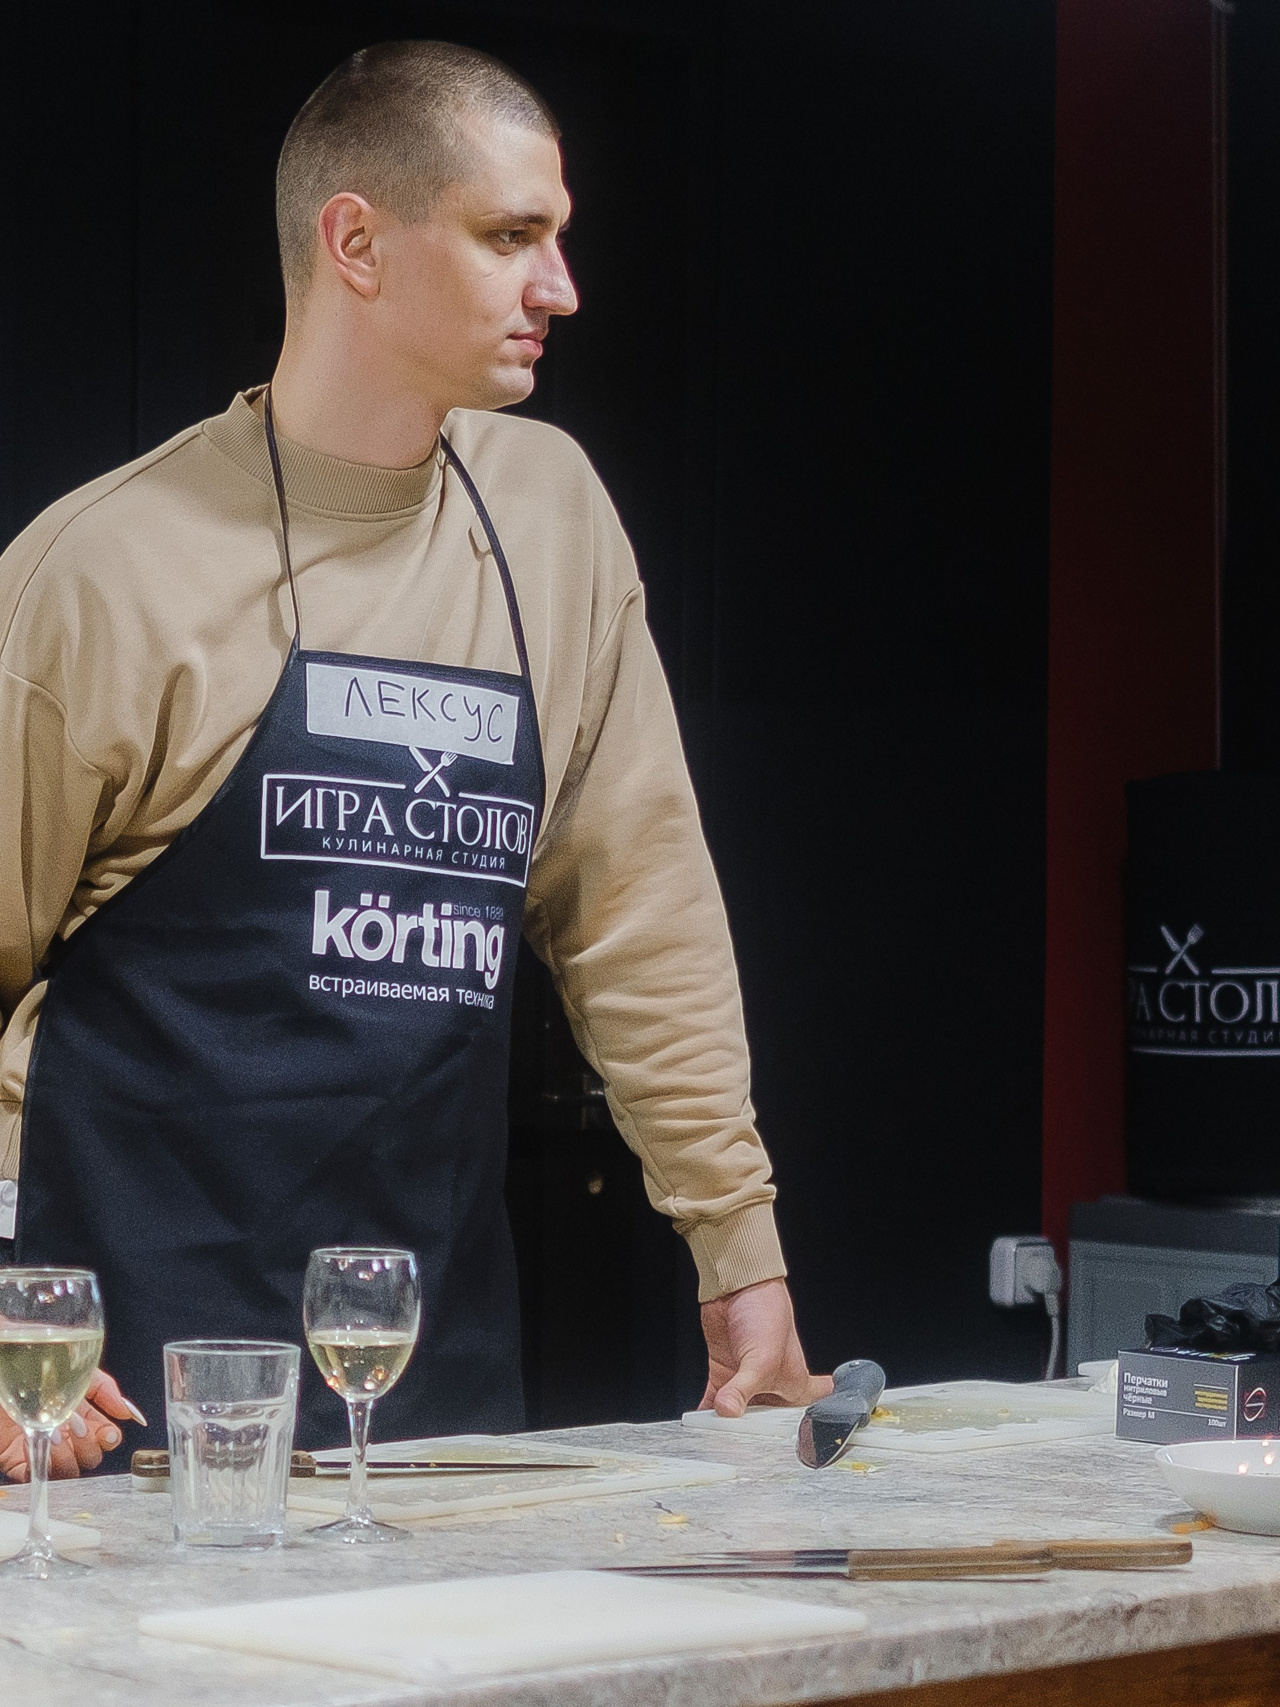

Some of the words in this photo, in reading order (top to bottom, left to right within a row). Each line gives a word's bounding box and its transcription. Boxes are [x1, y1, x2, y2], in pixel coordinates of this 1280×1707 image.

[344, 676, 504, 744] ЛЕКСУС
[275, 785, 395, 836] ИГРА
[405, 798, 530, 855] СТОЛОВ
[322, 836, 443, 863] КУЛИНАРНАЯ
[451, 850, 506, 871] СТУДИЯ
[453, 904, 481, 918] since
[312, 889, 505, 990] körting
[309, 974, 450, 1002] встраиваемая
[1208, 1029, 1280, 1045] СТУДИ
[1123, 1372, 1169, 1389] Перчатки
[1122, 1408, 1147, 1420] Размер
